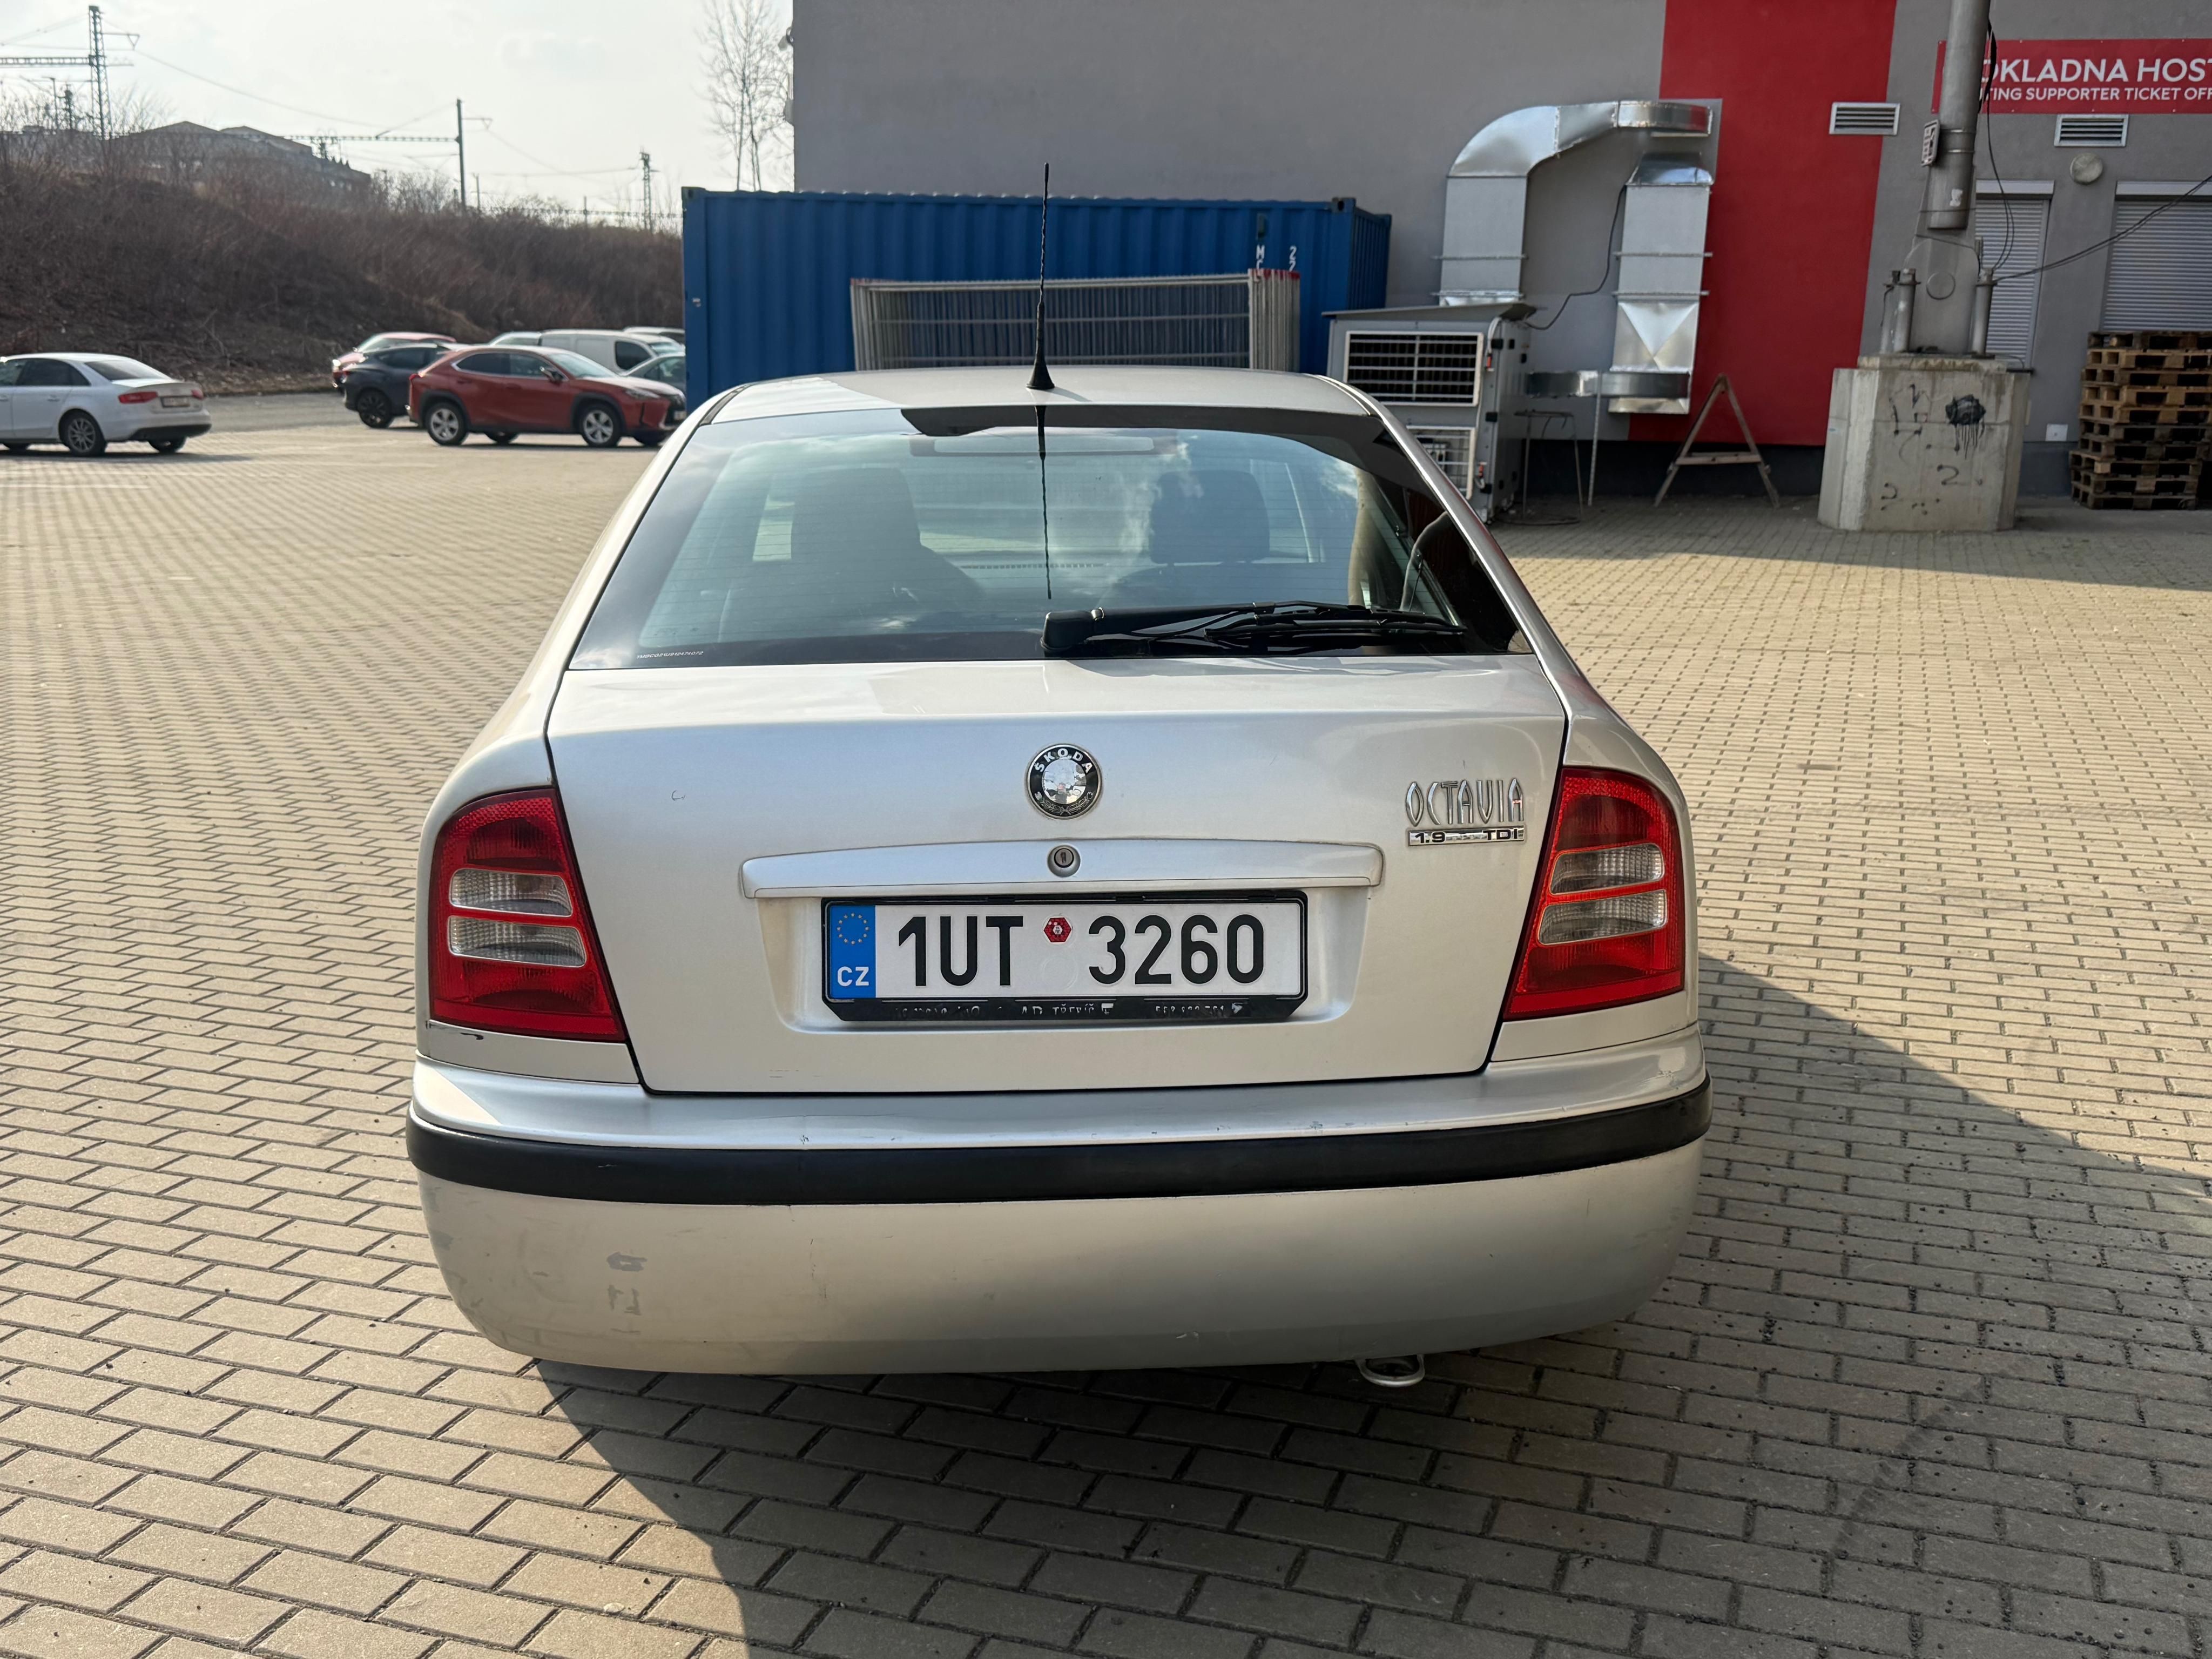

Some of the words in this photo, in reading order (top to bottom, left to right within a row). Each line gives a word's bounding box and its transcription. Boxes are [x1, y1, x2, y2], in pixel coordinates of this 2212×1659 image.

[1981, 59, 2129, 82] KLADNA
[2137, 58, 2212, 82] HOS
[2026, 87, 2120, 100] SUPPORTER
[2125, 87, 2181, 100] TICKET
[1034, 748, 1094, 774] ŠKODA
[1405, 778, 1525, 827] OCTAVIA
[1414, 831, 1446, 844] 1.9
[1483, 828, 1518, 841] TDI
[898, 915, 1024, 987] 1UT
[1088, 914, 1264, 985] 3260
[837, 966, 870, 986] CZ
